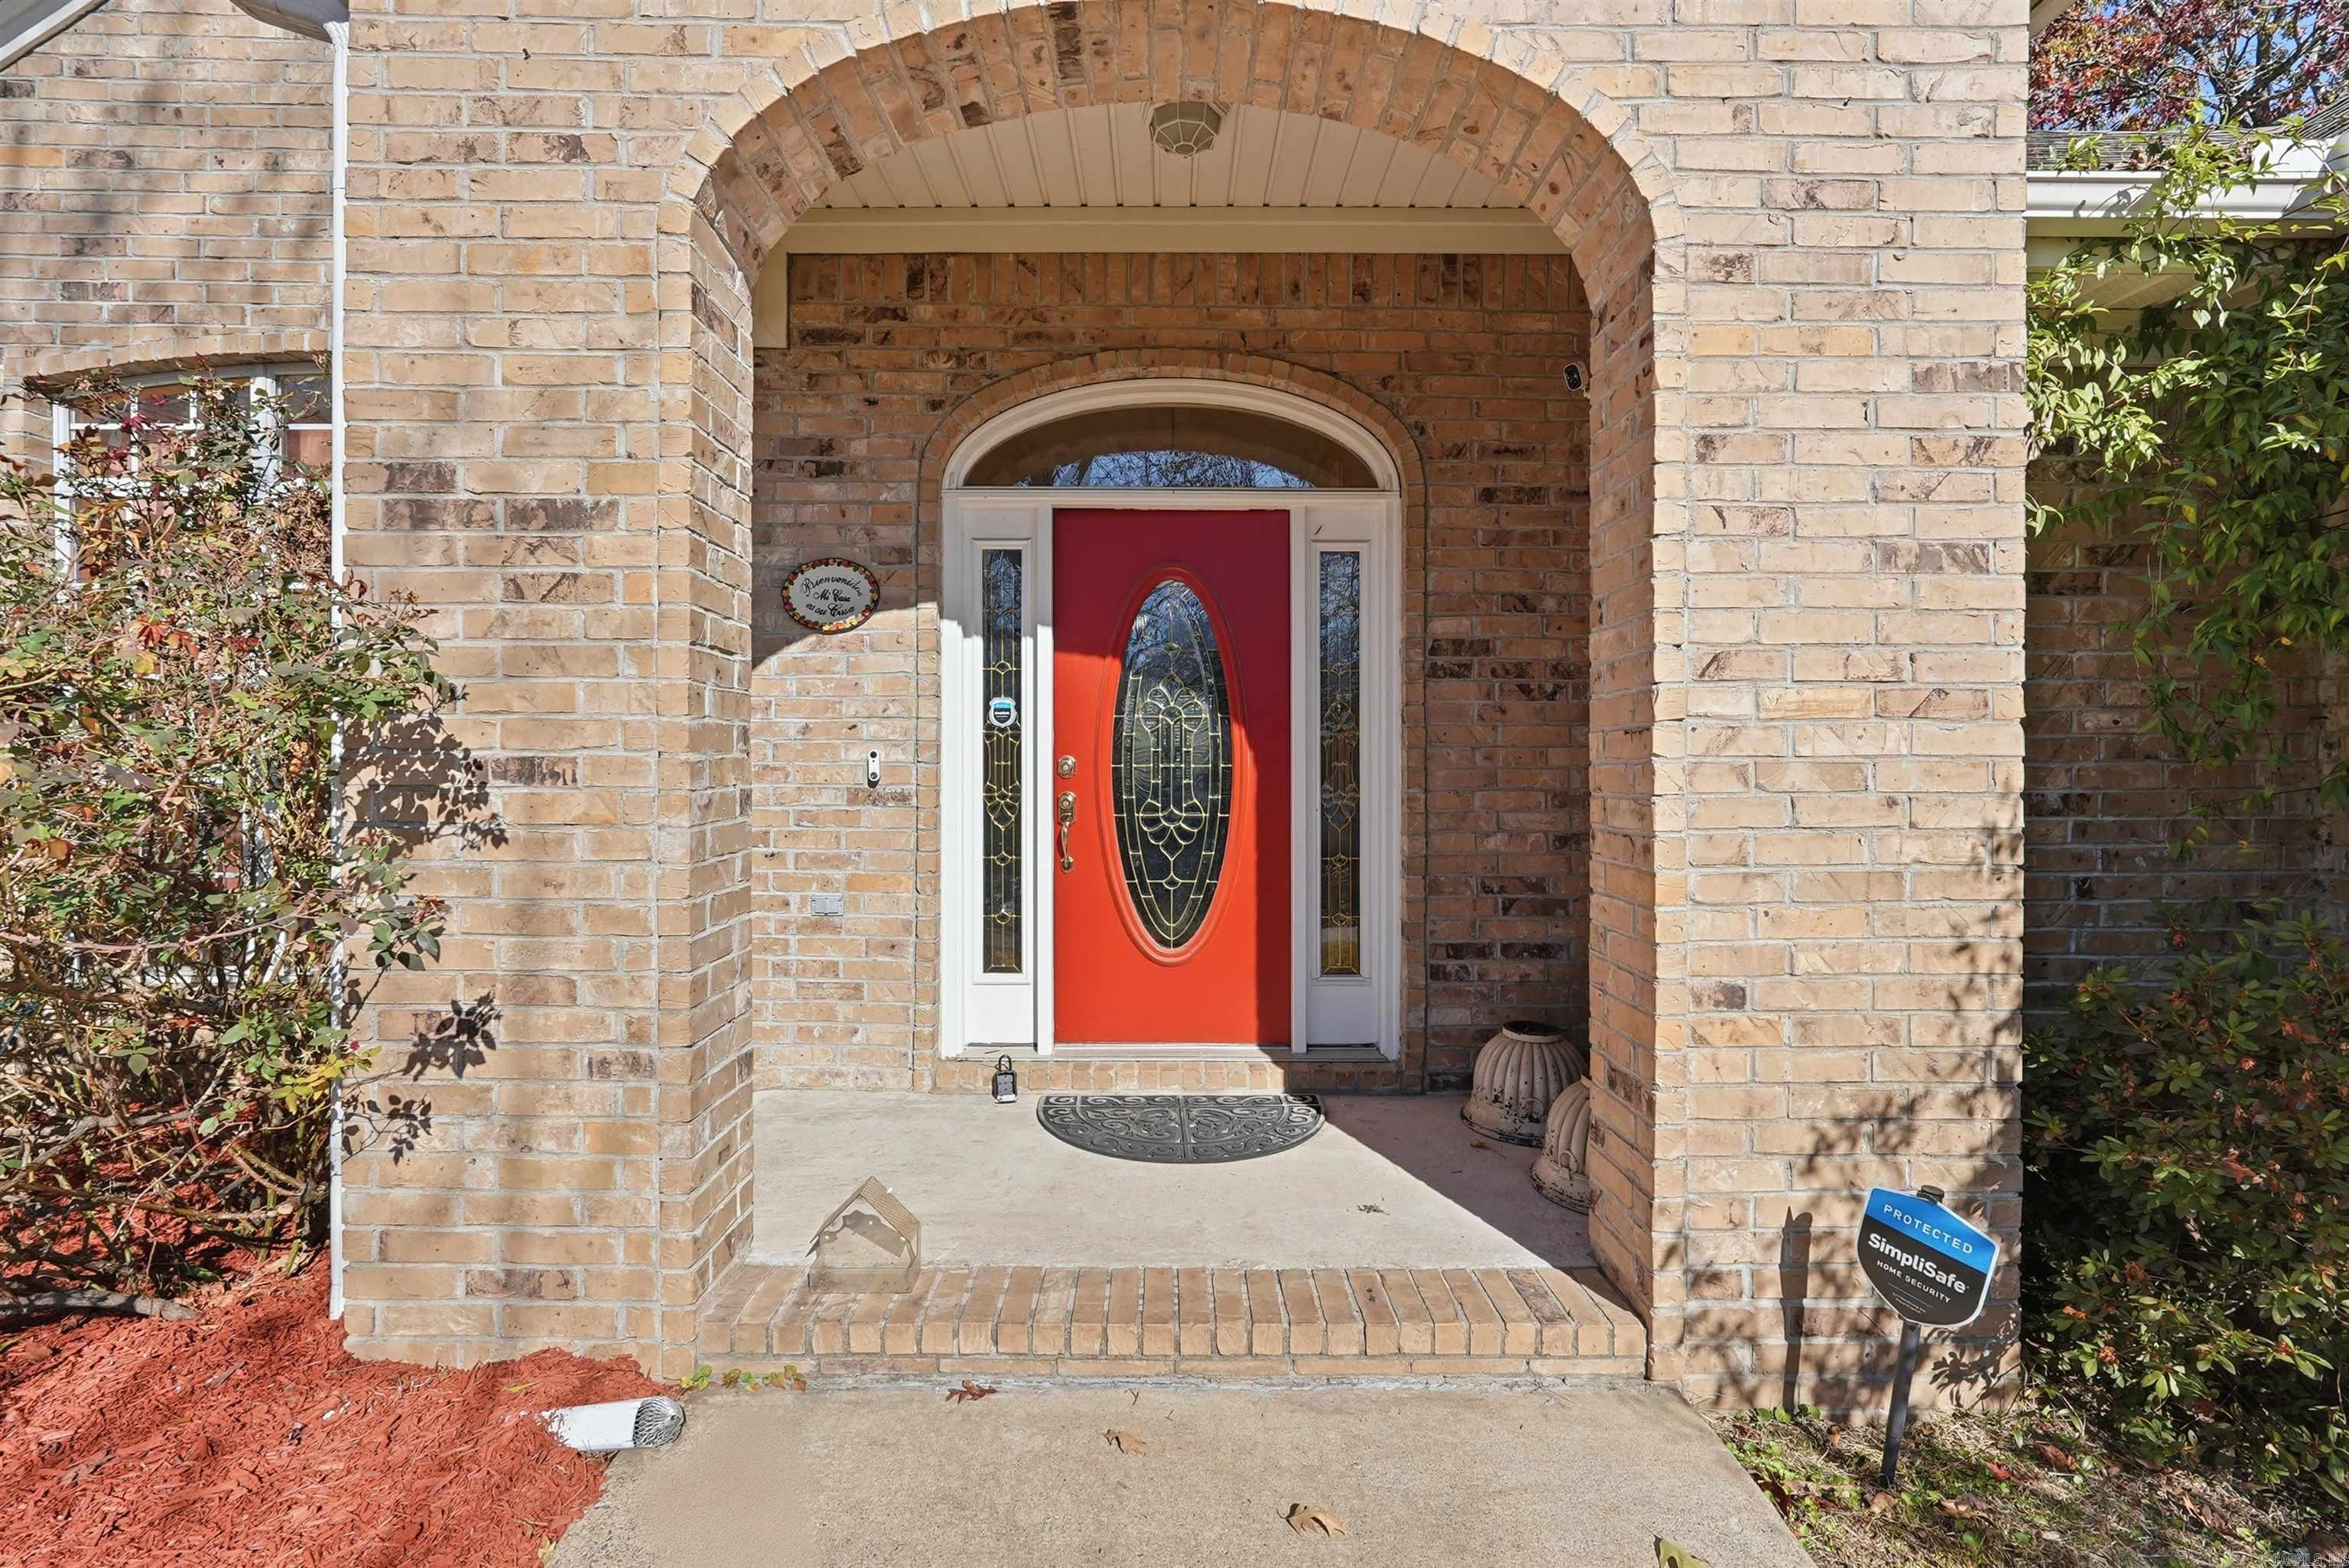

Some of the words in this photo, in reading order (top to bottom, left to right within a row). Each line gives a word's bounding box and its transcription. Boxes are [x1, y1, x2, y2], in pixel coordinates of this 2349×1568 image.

[1883, 1204, 1973, 1254] PROTECTED
[1868, 1232, 1967, 1294] SimpliSafe
[1876, 1260, 1903, 1278] HOME
[1905, 1274, 1951, 1303] SECURITY
